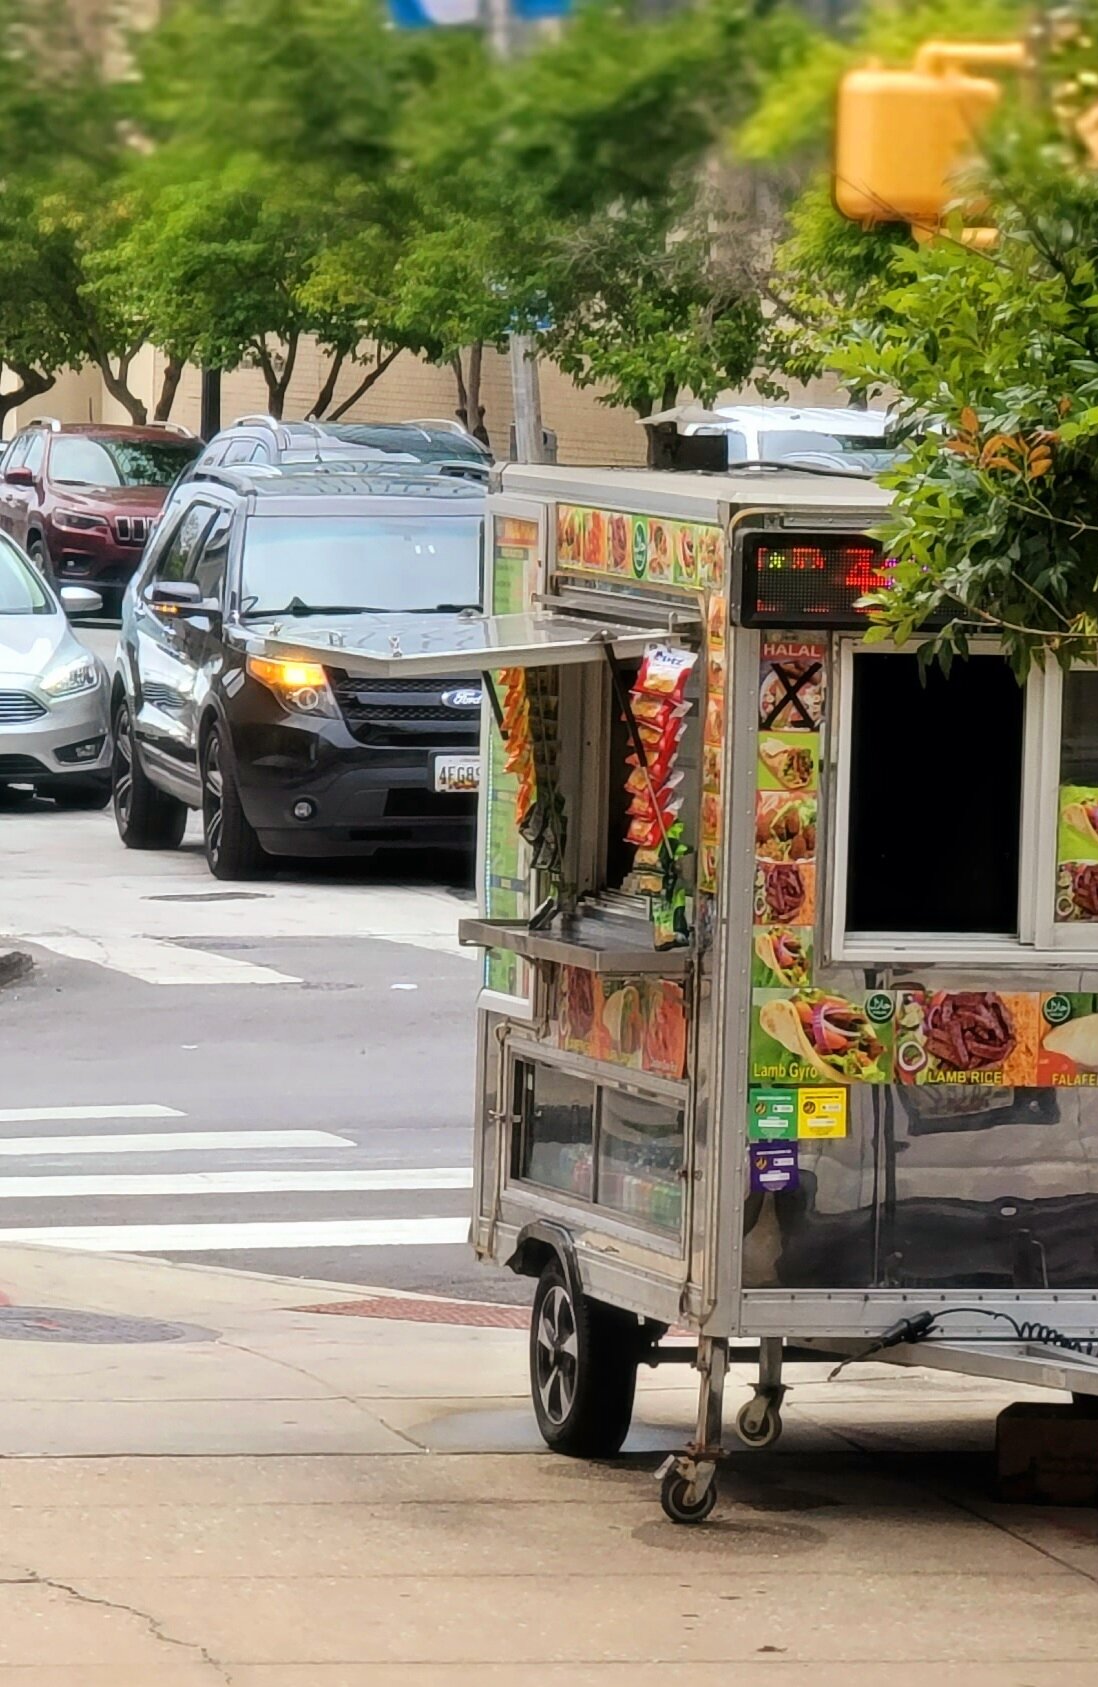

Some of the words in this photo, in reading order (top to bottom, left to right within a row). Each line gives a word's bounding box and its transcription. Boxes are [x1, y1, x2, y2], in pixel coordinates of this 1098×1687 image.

[764, 643, 821, 658] HALAL
[453, 691, 482, 705] Ford
[754, 1063, 786, 1078] Lamb
[789, 1062, 818, 1081] Gyro
[928, 1071, 967, 1084] LAMB
[970, 1071, 1003, 1084] RICE
